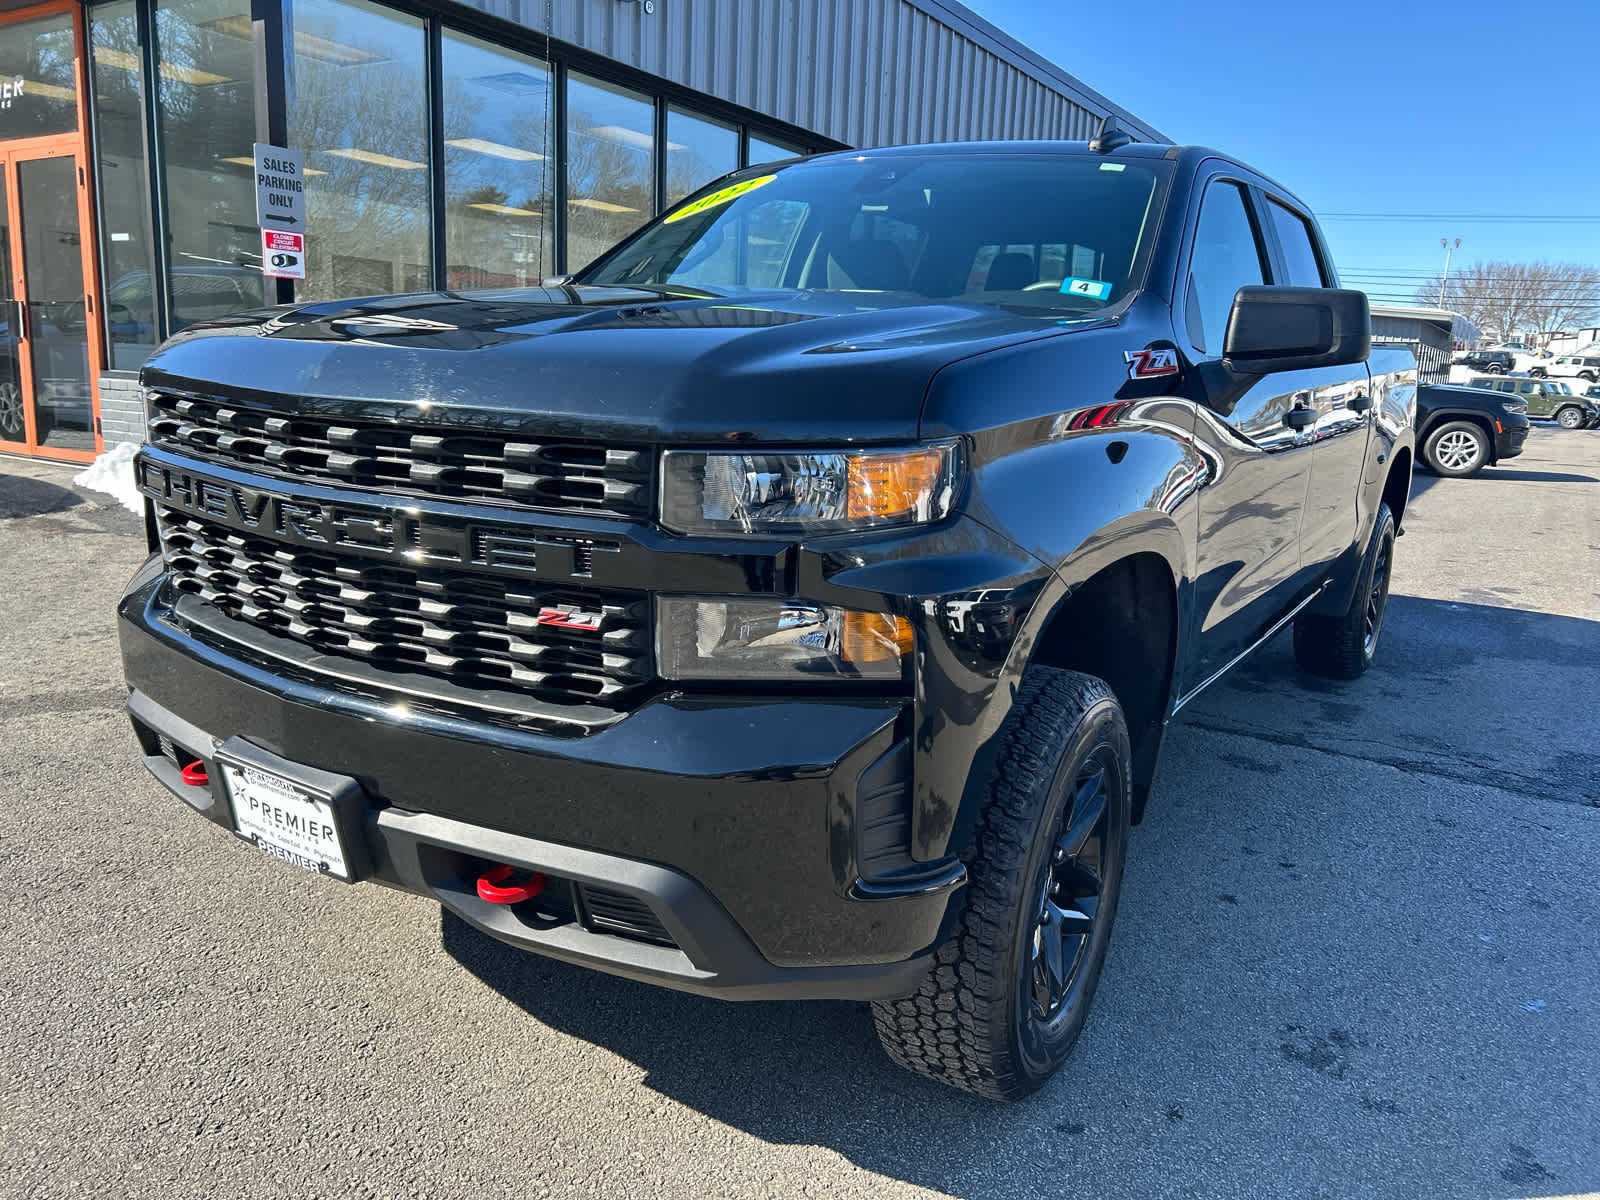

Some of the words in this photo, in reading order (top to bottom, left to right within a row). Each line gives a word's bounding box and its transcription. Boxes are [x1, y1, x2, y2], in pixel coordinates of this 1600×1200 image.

[263, 157, 296, 175] SALES
[258, 174, 303, 193] PARKING
[268, 193, 294, 209] ONLY
[1078, 282, 1090, 292] 4
[141, 460, 621, 578] CHEVROLET
[249, 796, 334, 842] PREMIER
[257, 840, 321, 874] PREMIER
